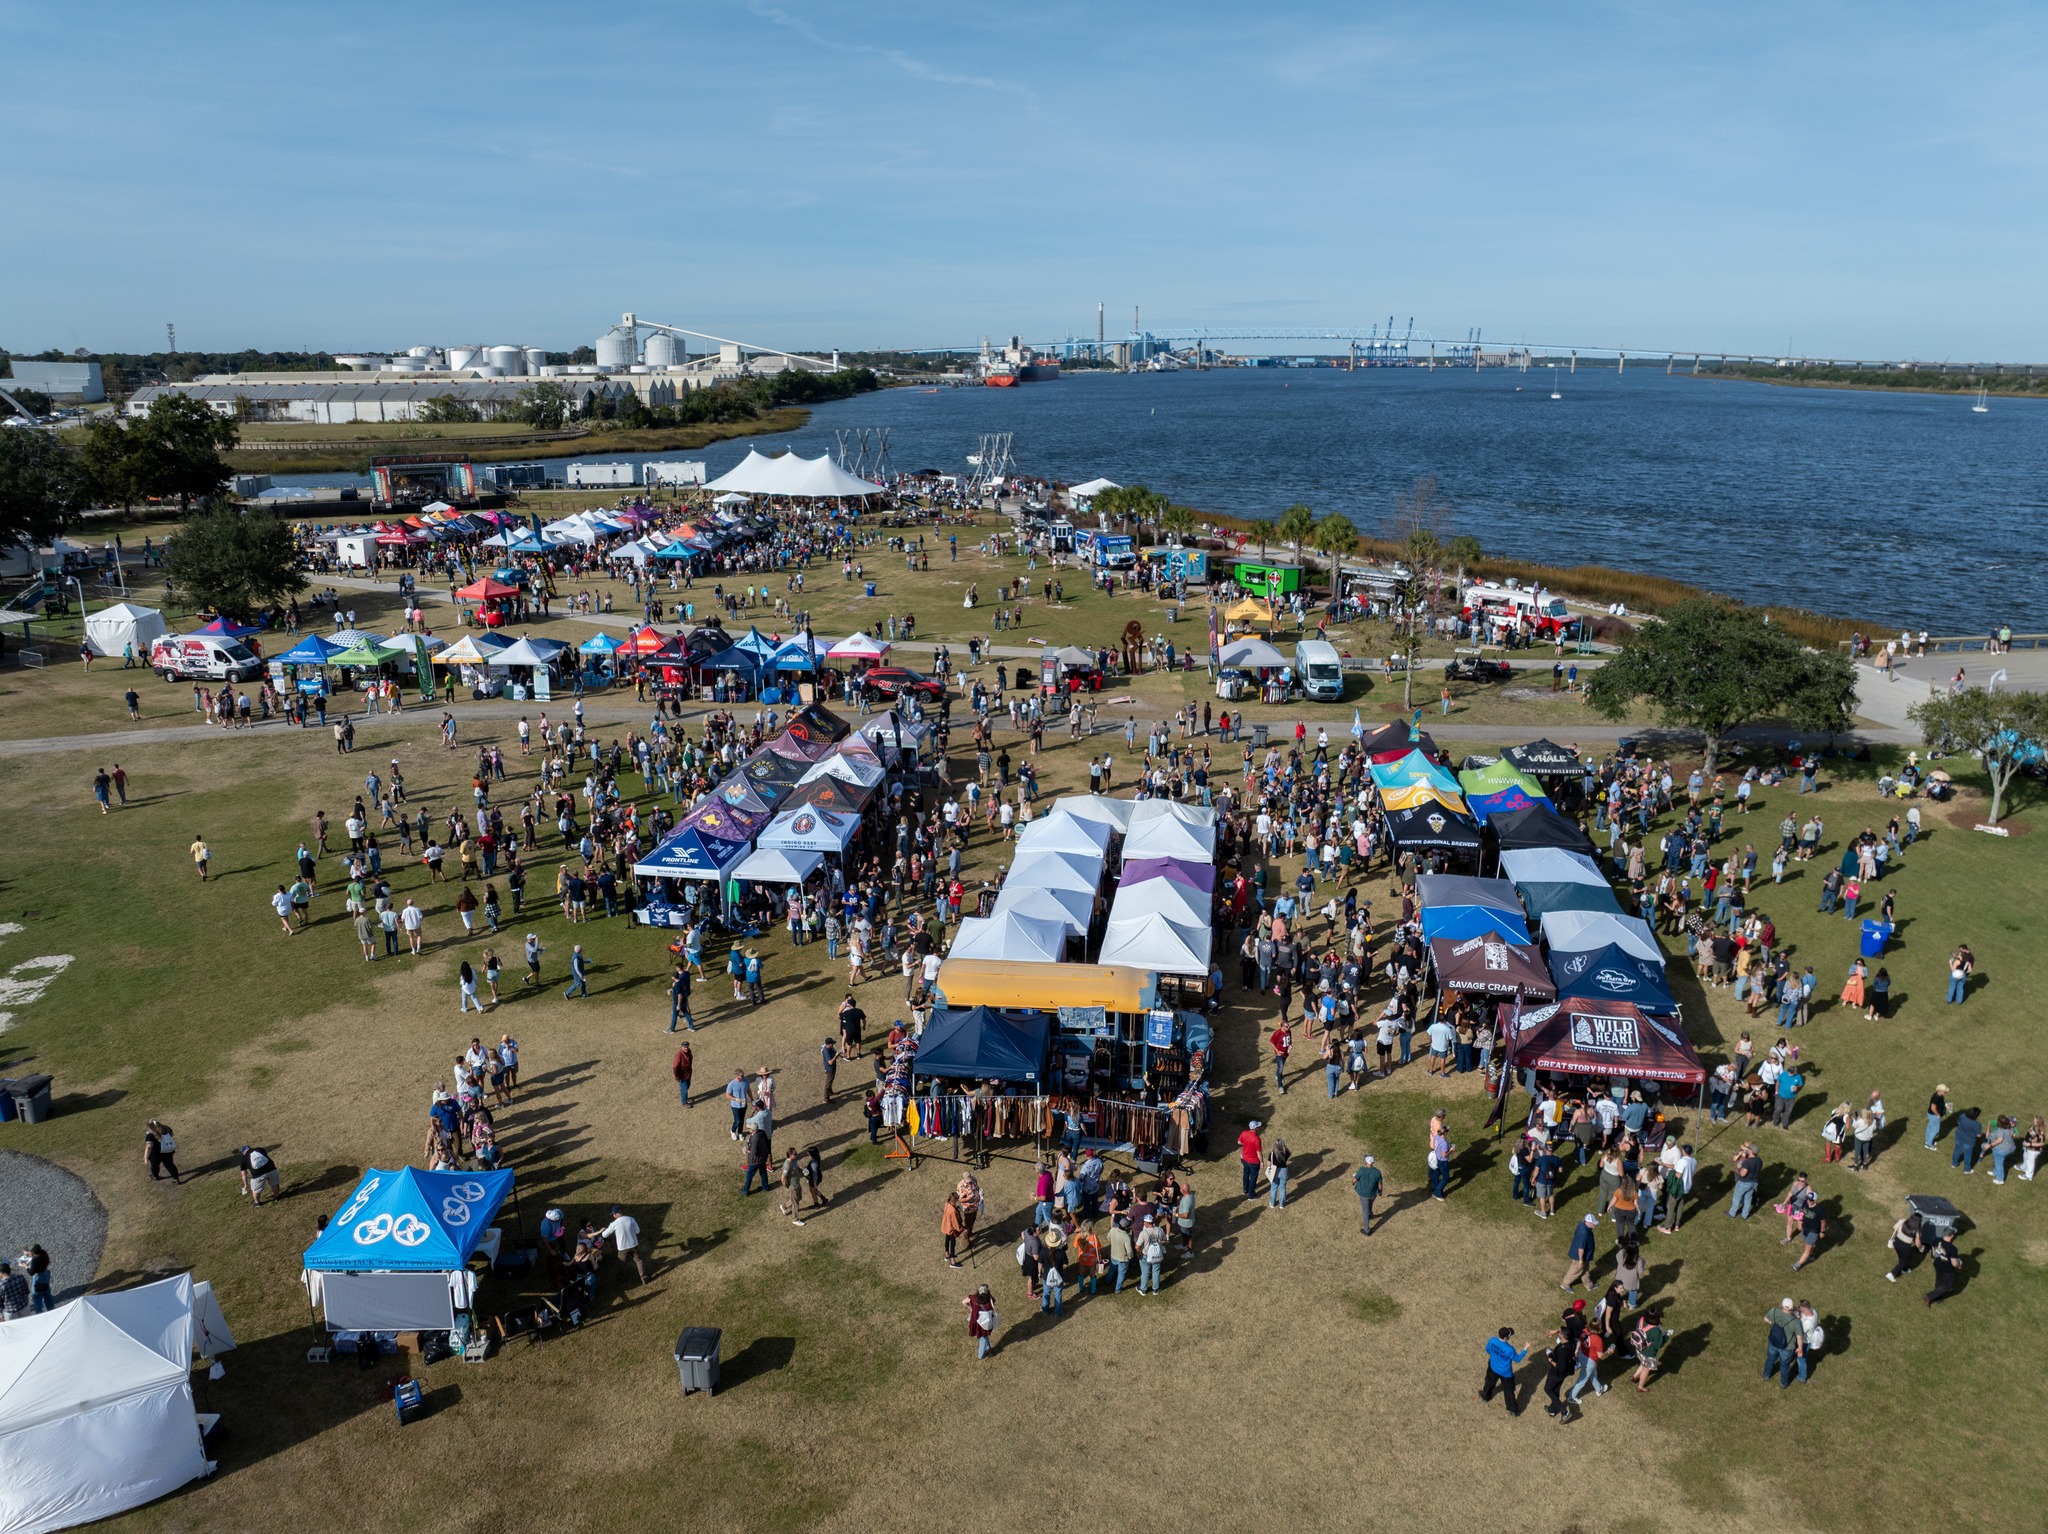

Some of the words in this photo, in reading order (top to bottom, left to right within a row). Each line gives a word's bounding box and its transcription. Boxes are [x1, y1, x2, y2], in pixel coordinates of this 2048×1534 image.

[1528, 755, 1567, 763] WHALE
[1423, 839, 1451, 847] ORIGINAL
[1448, 980, 1486, 990] SAVAGE
[1487, 983, 1519, 993] CRAFT
[1593, 1018, 1633, 1032] WILD
[1595, 1030, 1634, 1044] HEART
[1530, 1058, 1537, 1066] A
[1537, 1059, 1567, 1070] GREAT
[1567, 1062, 1597, 1073] STORY
[1597, 1065, 1607, 1074] IS
[1607, 1067, 1644, 1077] ALWAYS
[1645, 1069, 1687, 1079] BREWING
[311, 1258, 351, 1266] TWISTED
[353, 1258, 384, 1266] JACK'S
